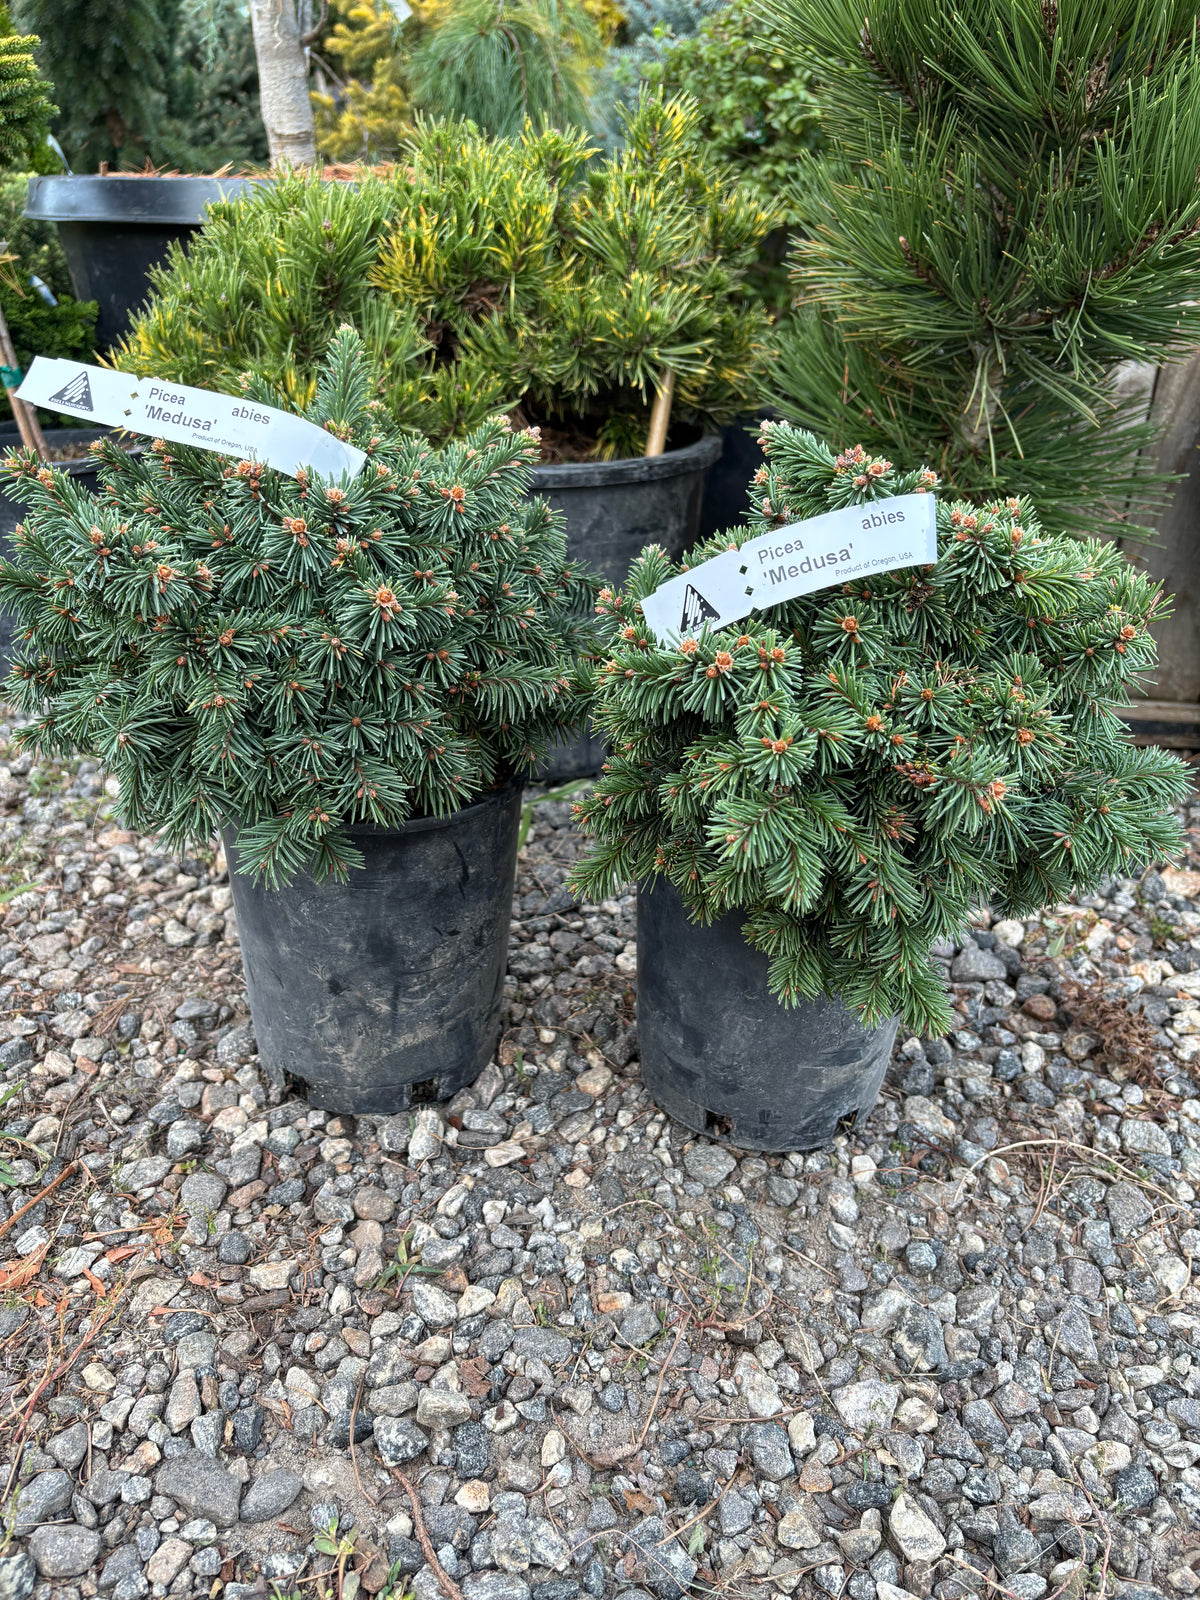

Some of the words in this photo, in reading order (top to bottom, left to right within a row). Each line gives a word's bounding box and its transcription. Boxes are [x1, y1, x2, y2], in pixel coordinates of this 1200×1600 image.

[144, 404, 218, 432] 'Medusa'
[148, 387, 186, 406] Picea
[231, 406, 271, 425] abies
[192, 432, 214, 443] Product
[220, 439, 243, 450] Oregon,
[244, 445, 258, 454] USA
[757, 539, 805, 565] Picea
[861, 511, 906, 530] abies
[763, 542, 854, 586] 'Medusa'
[835, 563, 863, 577] Product
[863, 561, 871, 569] of
[871, 555, 899, 566] Oregon,
[898, 551, 914, 561] USA
